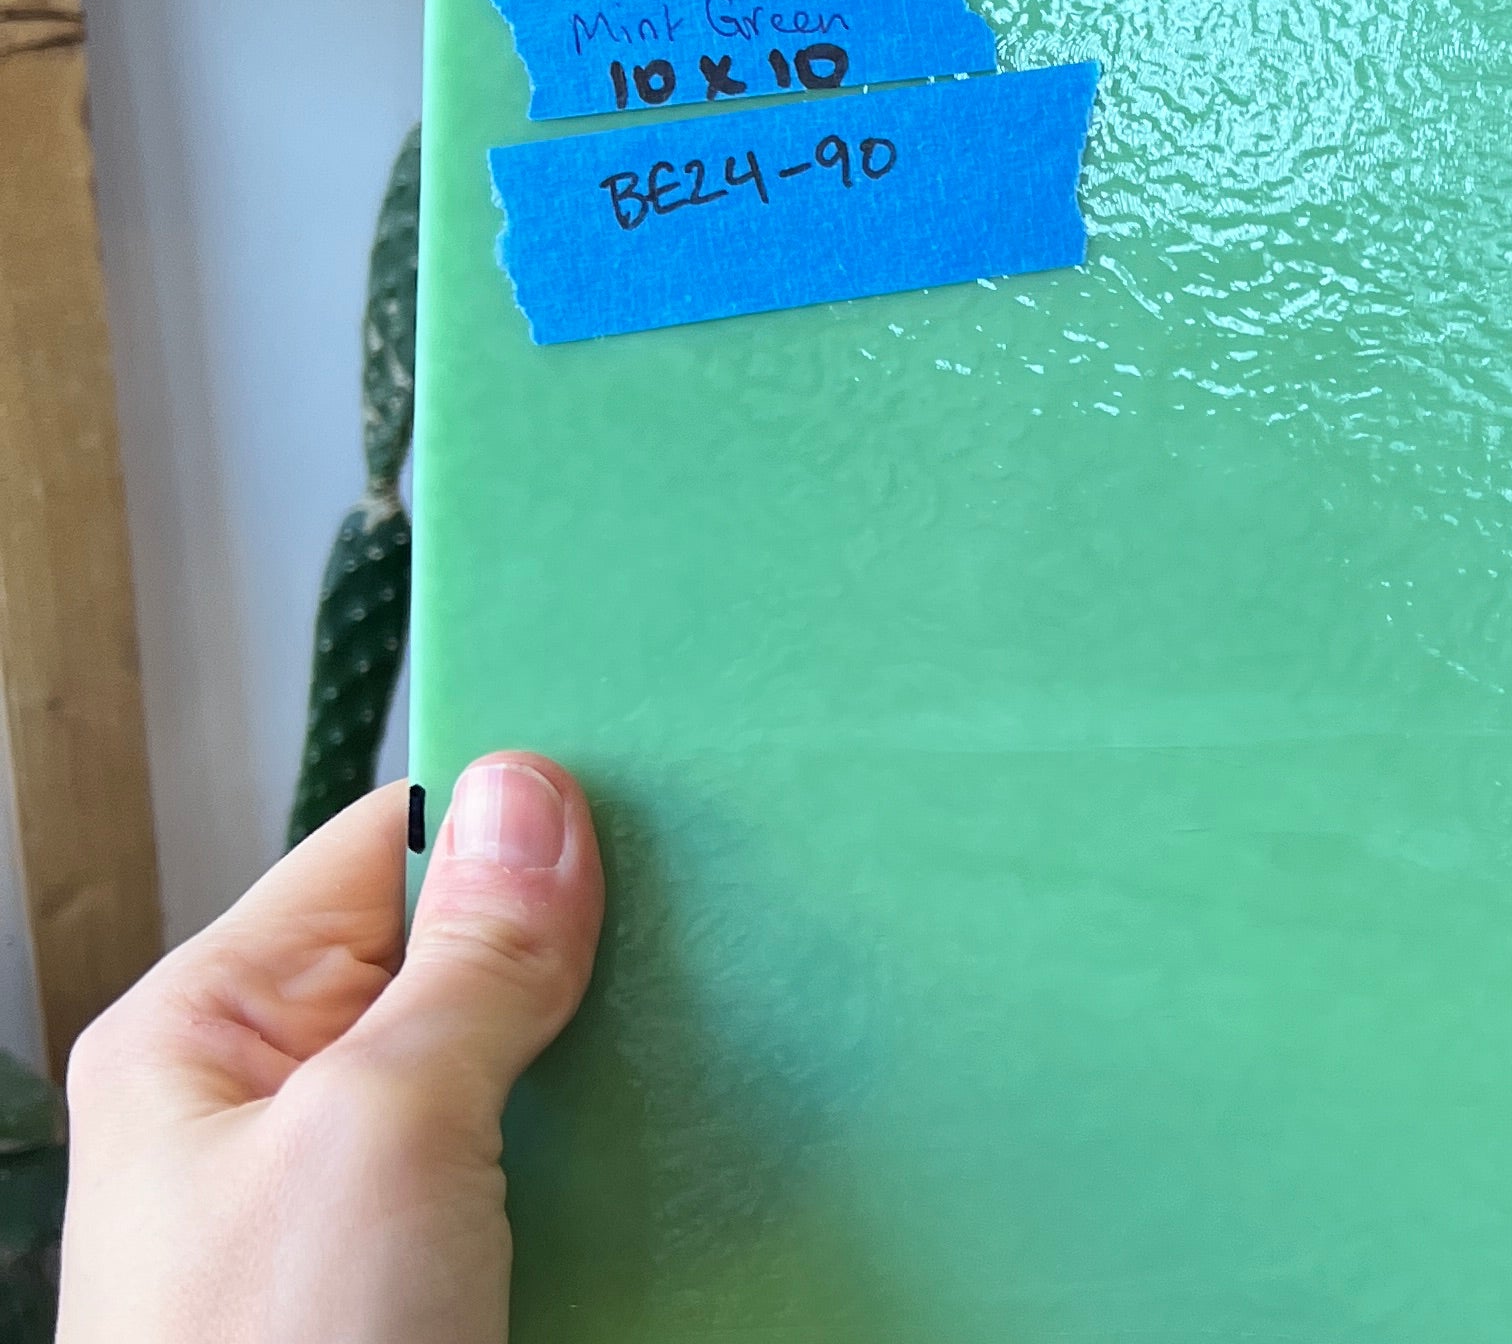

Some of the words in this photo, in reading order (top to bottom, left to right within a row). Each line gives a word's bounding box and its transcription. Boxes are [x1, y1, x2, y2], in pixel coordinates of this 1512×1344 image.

[571, 5, 684, 55] Mint
[609, 58, 676, 110] 10
[767, 42, 850, 90] 10
[600, 134, 898, 230] BE24-90
